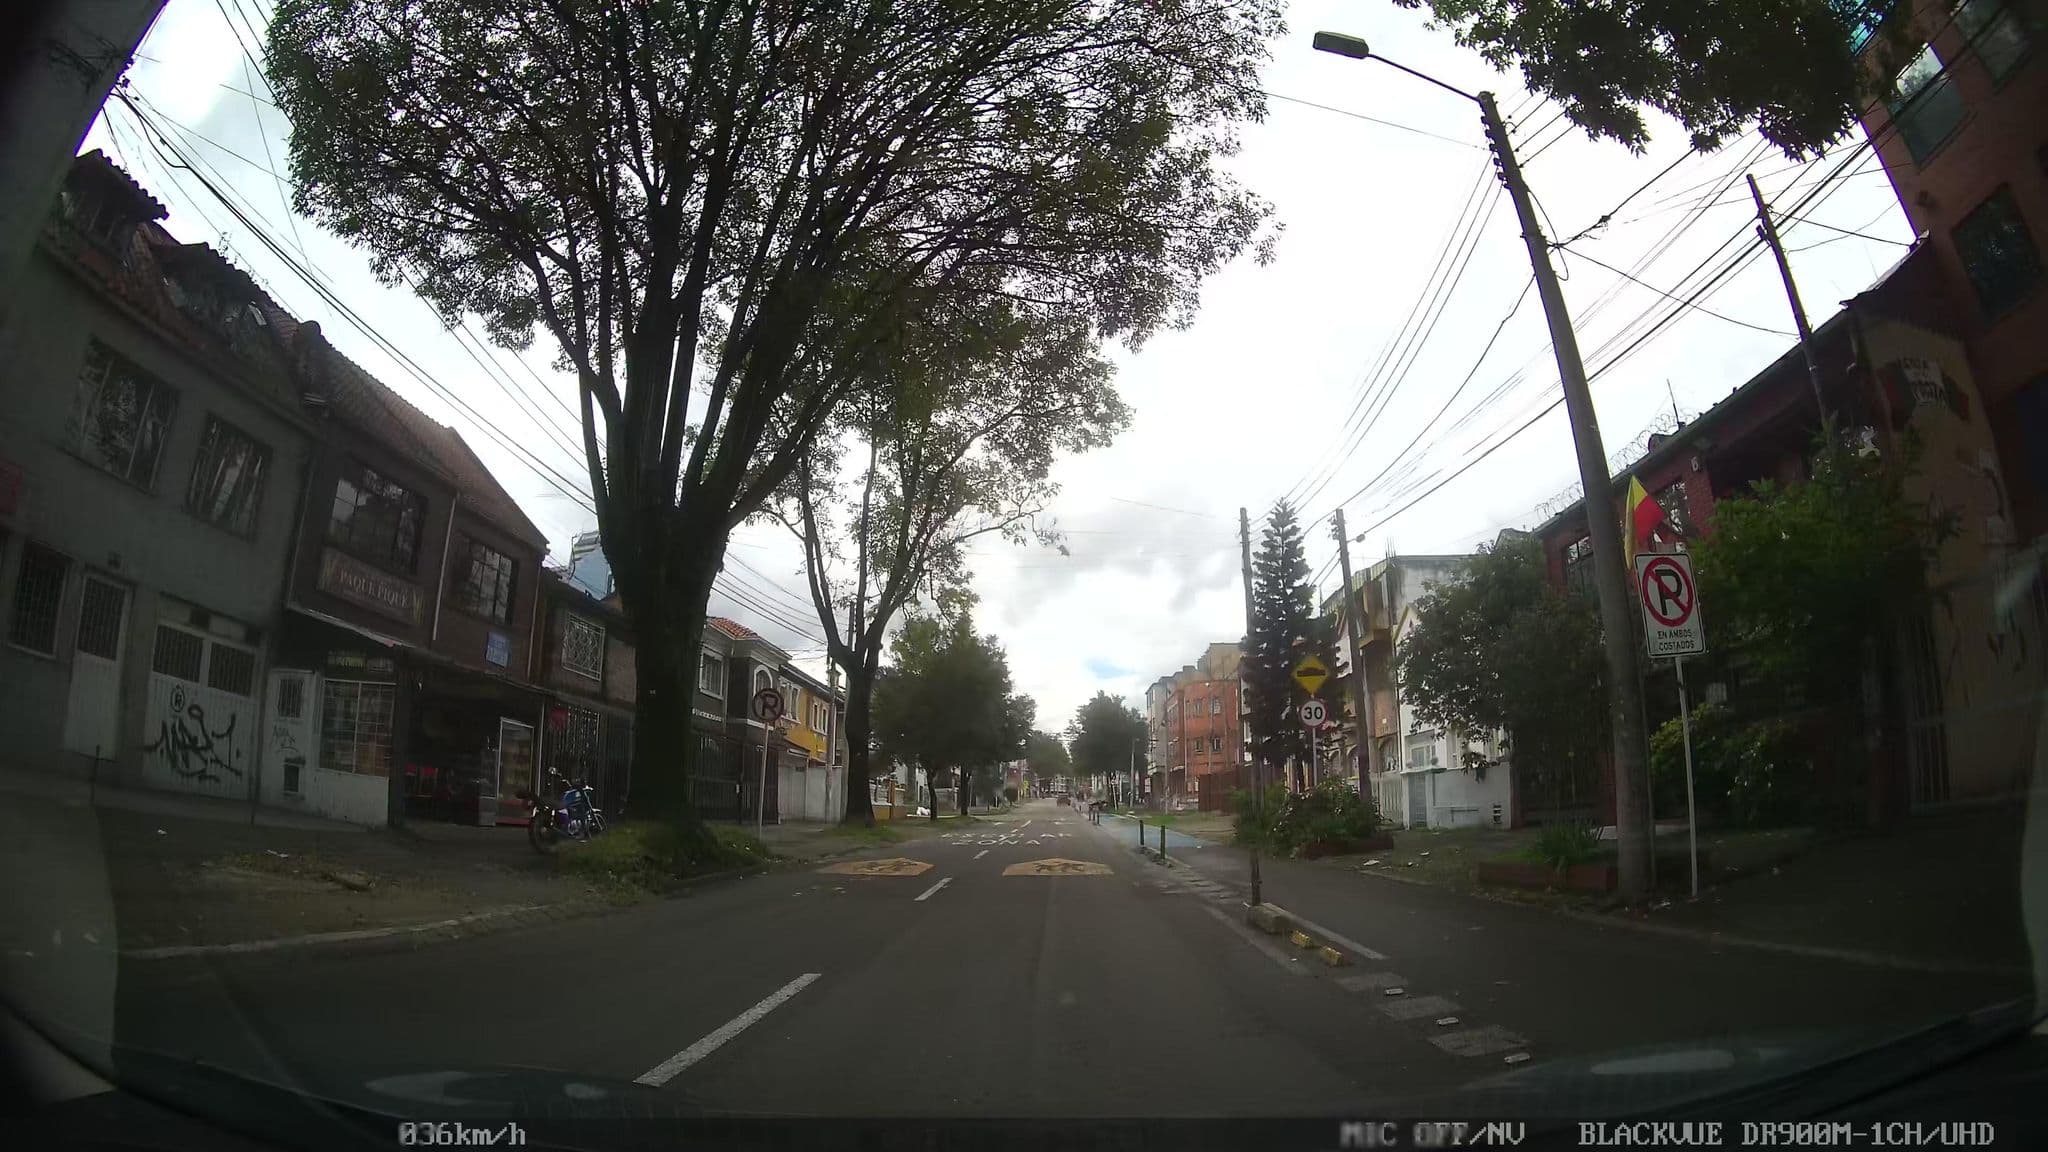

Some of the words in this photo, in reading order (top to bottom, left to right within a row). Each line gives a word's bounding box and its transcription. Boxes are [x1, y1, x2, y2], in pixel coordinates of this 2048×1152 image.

[1654, 568, 1682, 616] P
[1657, 630, 1668, 640] EN
[1669, 628, 1694, 640] AMBOS
[1658, 640, 1695, 652] COSTADOS
[1304, 706, 1323, 720] 30
